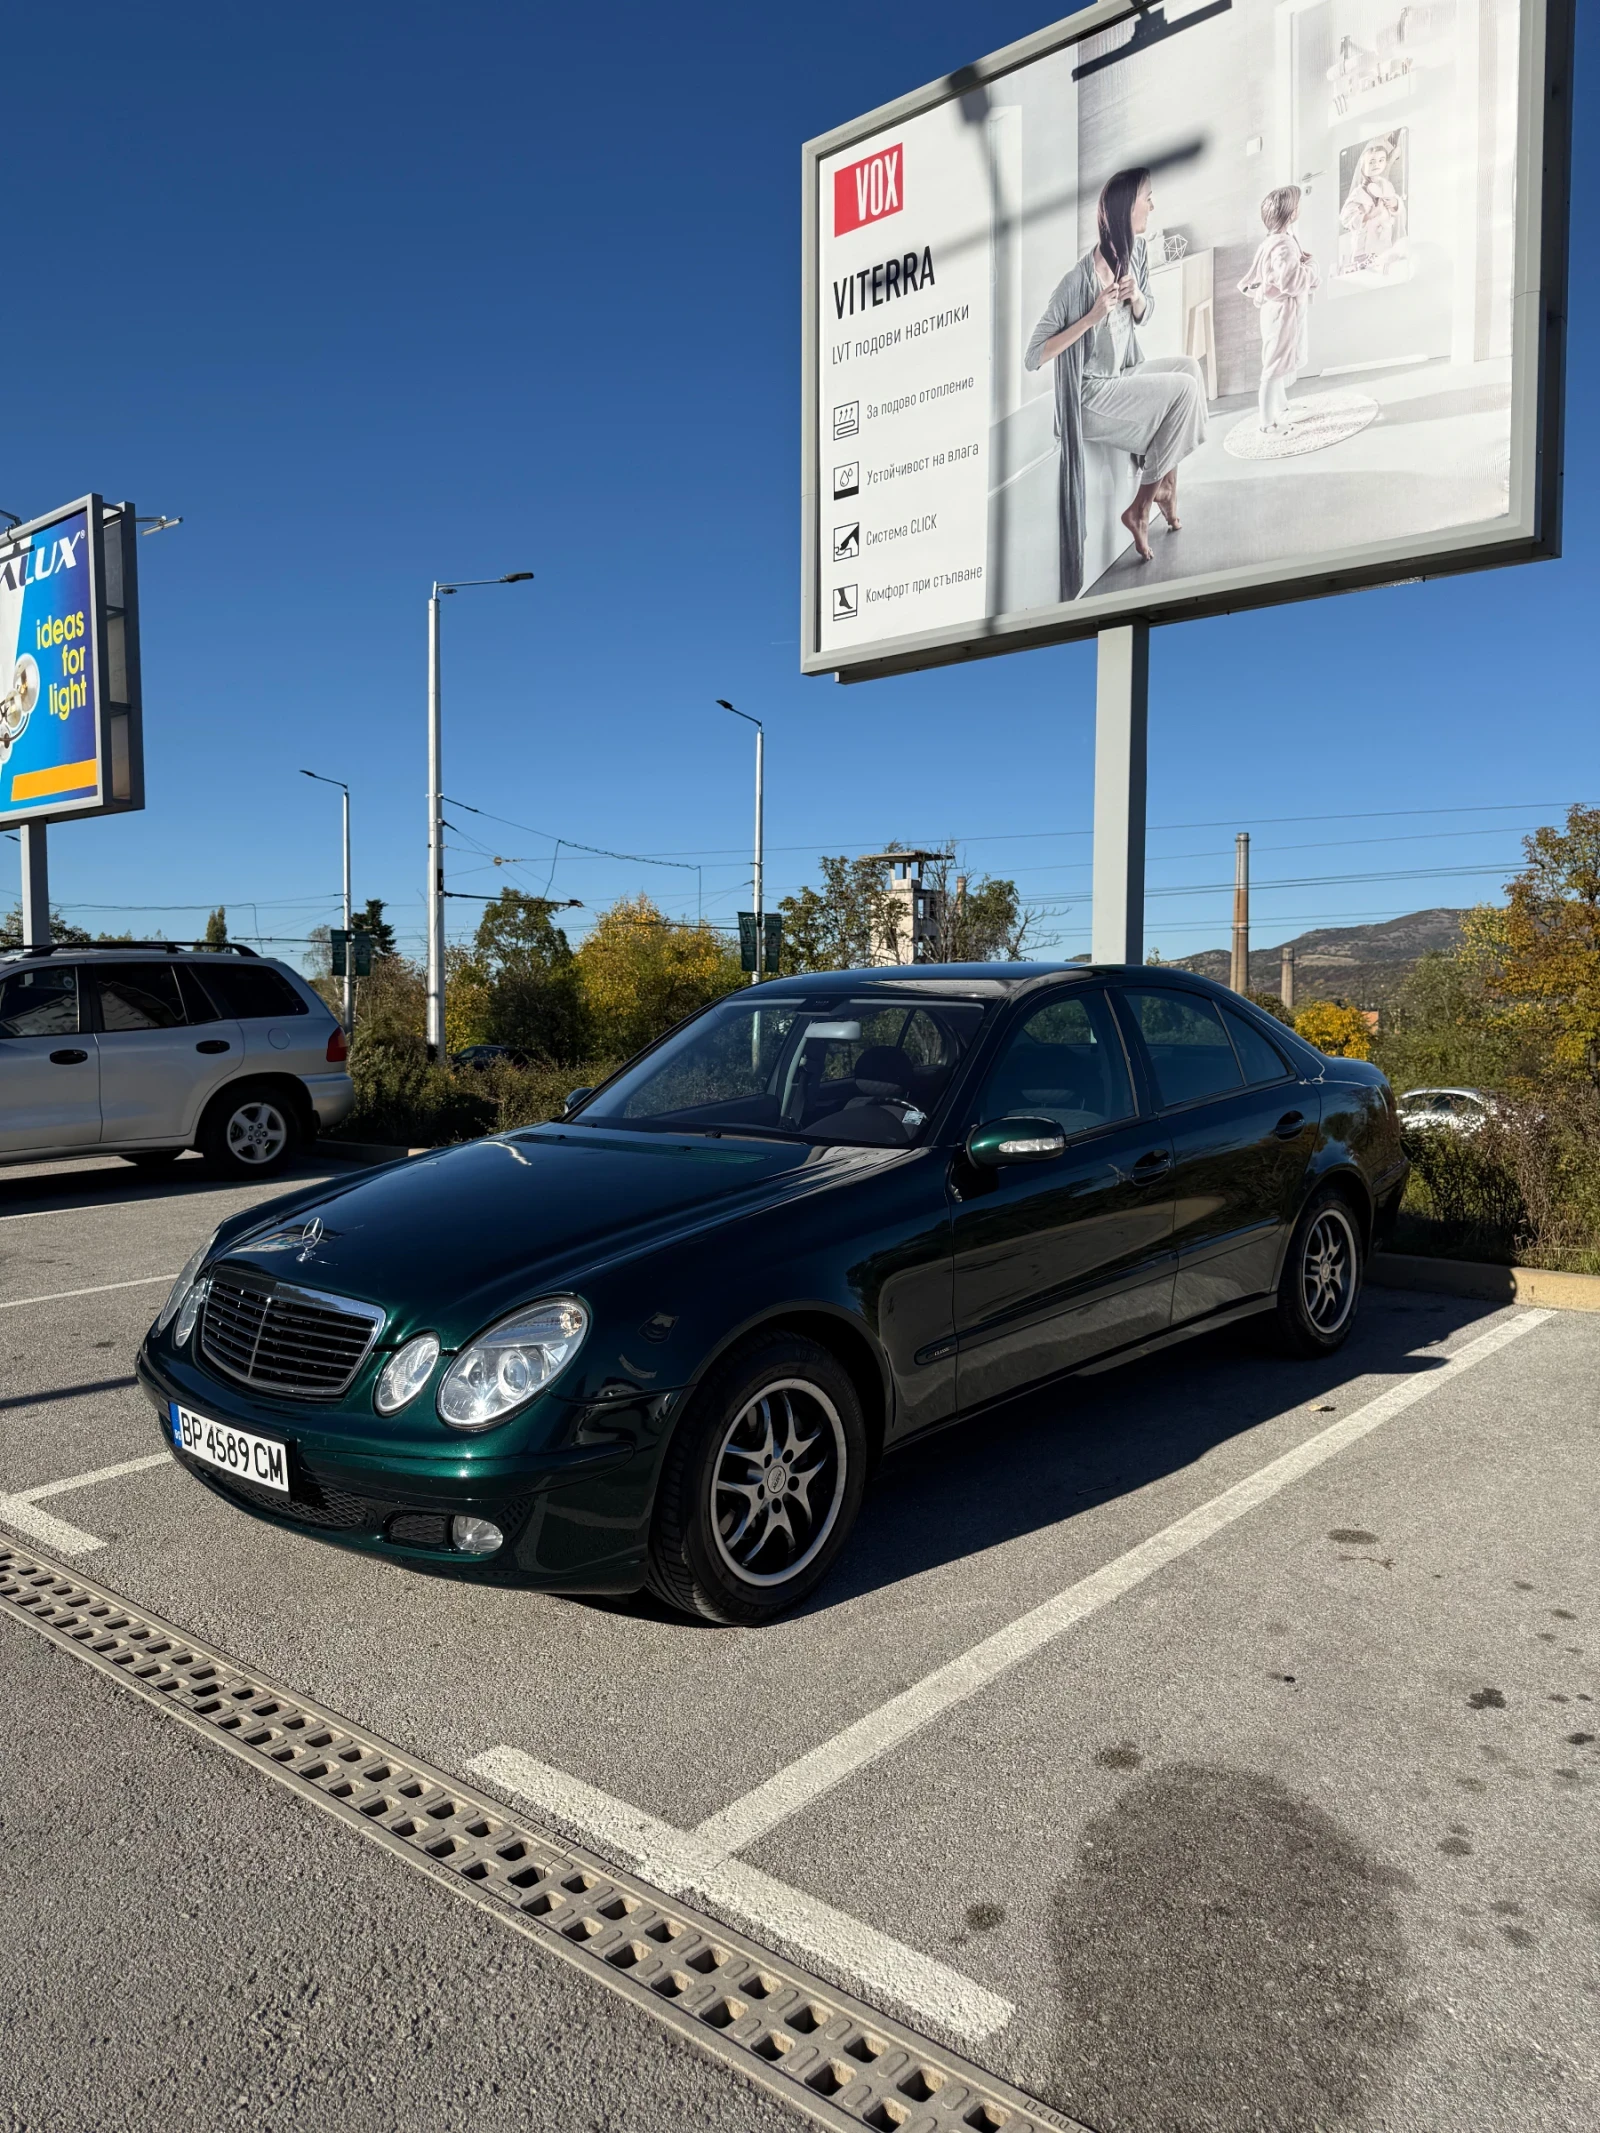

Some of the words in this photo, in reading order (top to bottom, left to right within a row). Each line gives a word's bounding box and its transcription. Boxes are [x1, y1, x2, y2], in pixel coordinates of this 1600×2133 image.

[855, 150, 899, 222] VOX
[833, 245, 936, 320] VITERRA
[832, 341, 851, 365] LVT
[855, 328, 901, 358] подови
[906, 304, 970, 341] настилки
[866, 404, 878, 420] За
[881, 395, 917, 417] подово
[919, 376, 975, 406] отопление
[866, 456, 930, 486] Устойчивост
[932, 451, 945, 467] на
[947, 443, 980, 463] влага
[866, 524, 908, 546] Система
[910, 513, 938, 535] CLICK
[866, 580, 910, 604] Комфорт
[912, 577, 931, 595] при
[933, 565, 983, 588] стъпване
[36, 610, 85, 650] ideas
[61, 642, 86, 677] for
[48, 674, 87, 721] light
[181, 1411, 203, 1451] BP
[206, 1424, 250, 1473] 4589
[253, 1441, 285, 1486] CM
